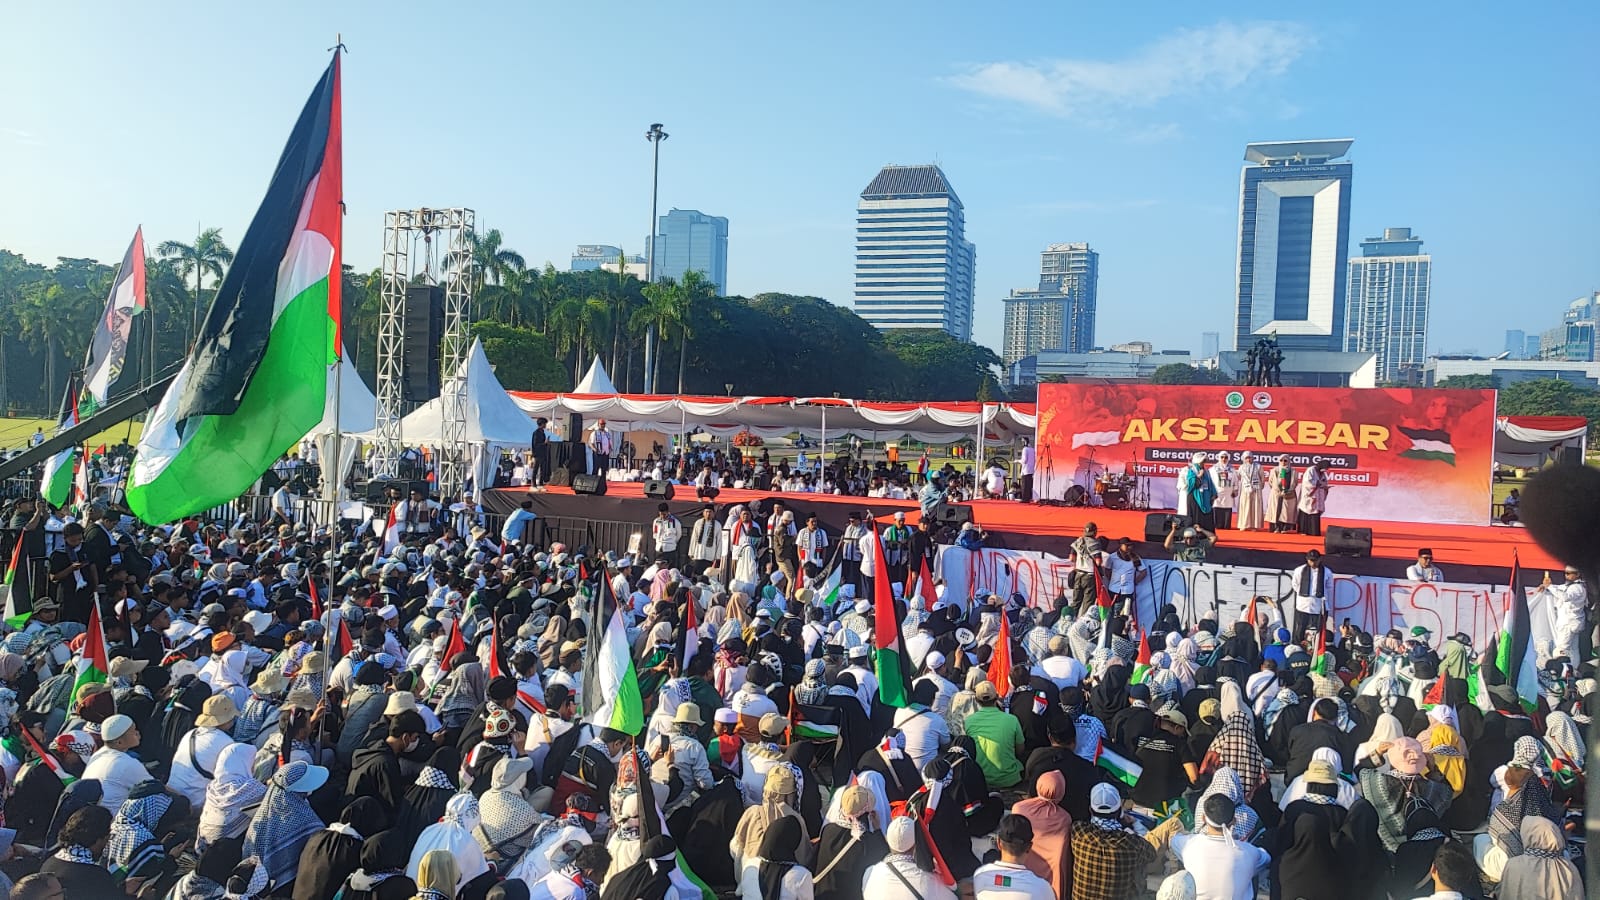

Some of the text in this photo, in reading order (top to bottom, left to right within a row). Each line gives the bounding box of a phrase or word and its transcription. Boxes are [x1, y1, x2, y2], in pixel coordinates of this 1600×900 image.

[1123, 417, 1390, 450] AKSI AKBAR
[1324, 471, 1370, 483] Massal
